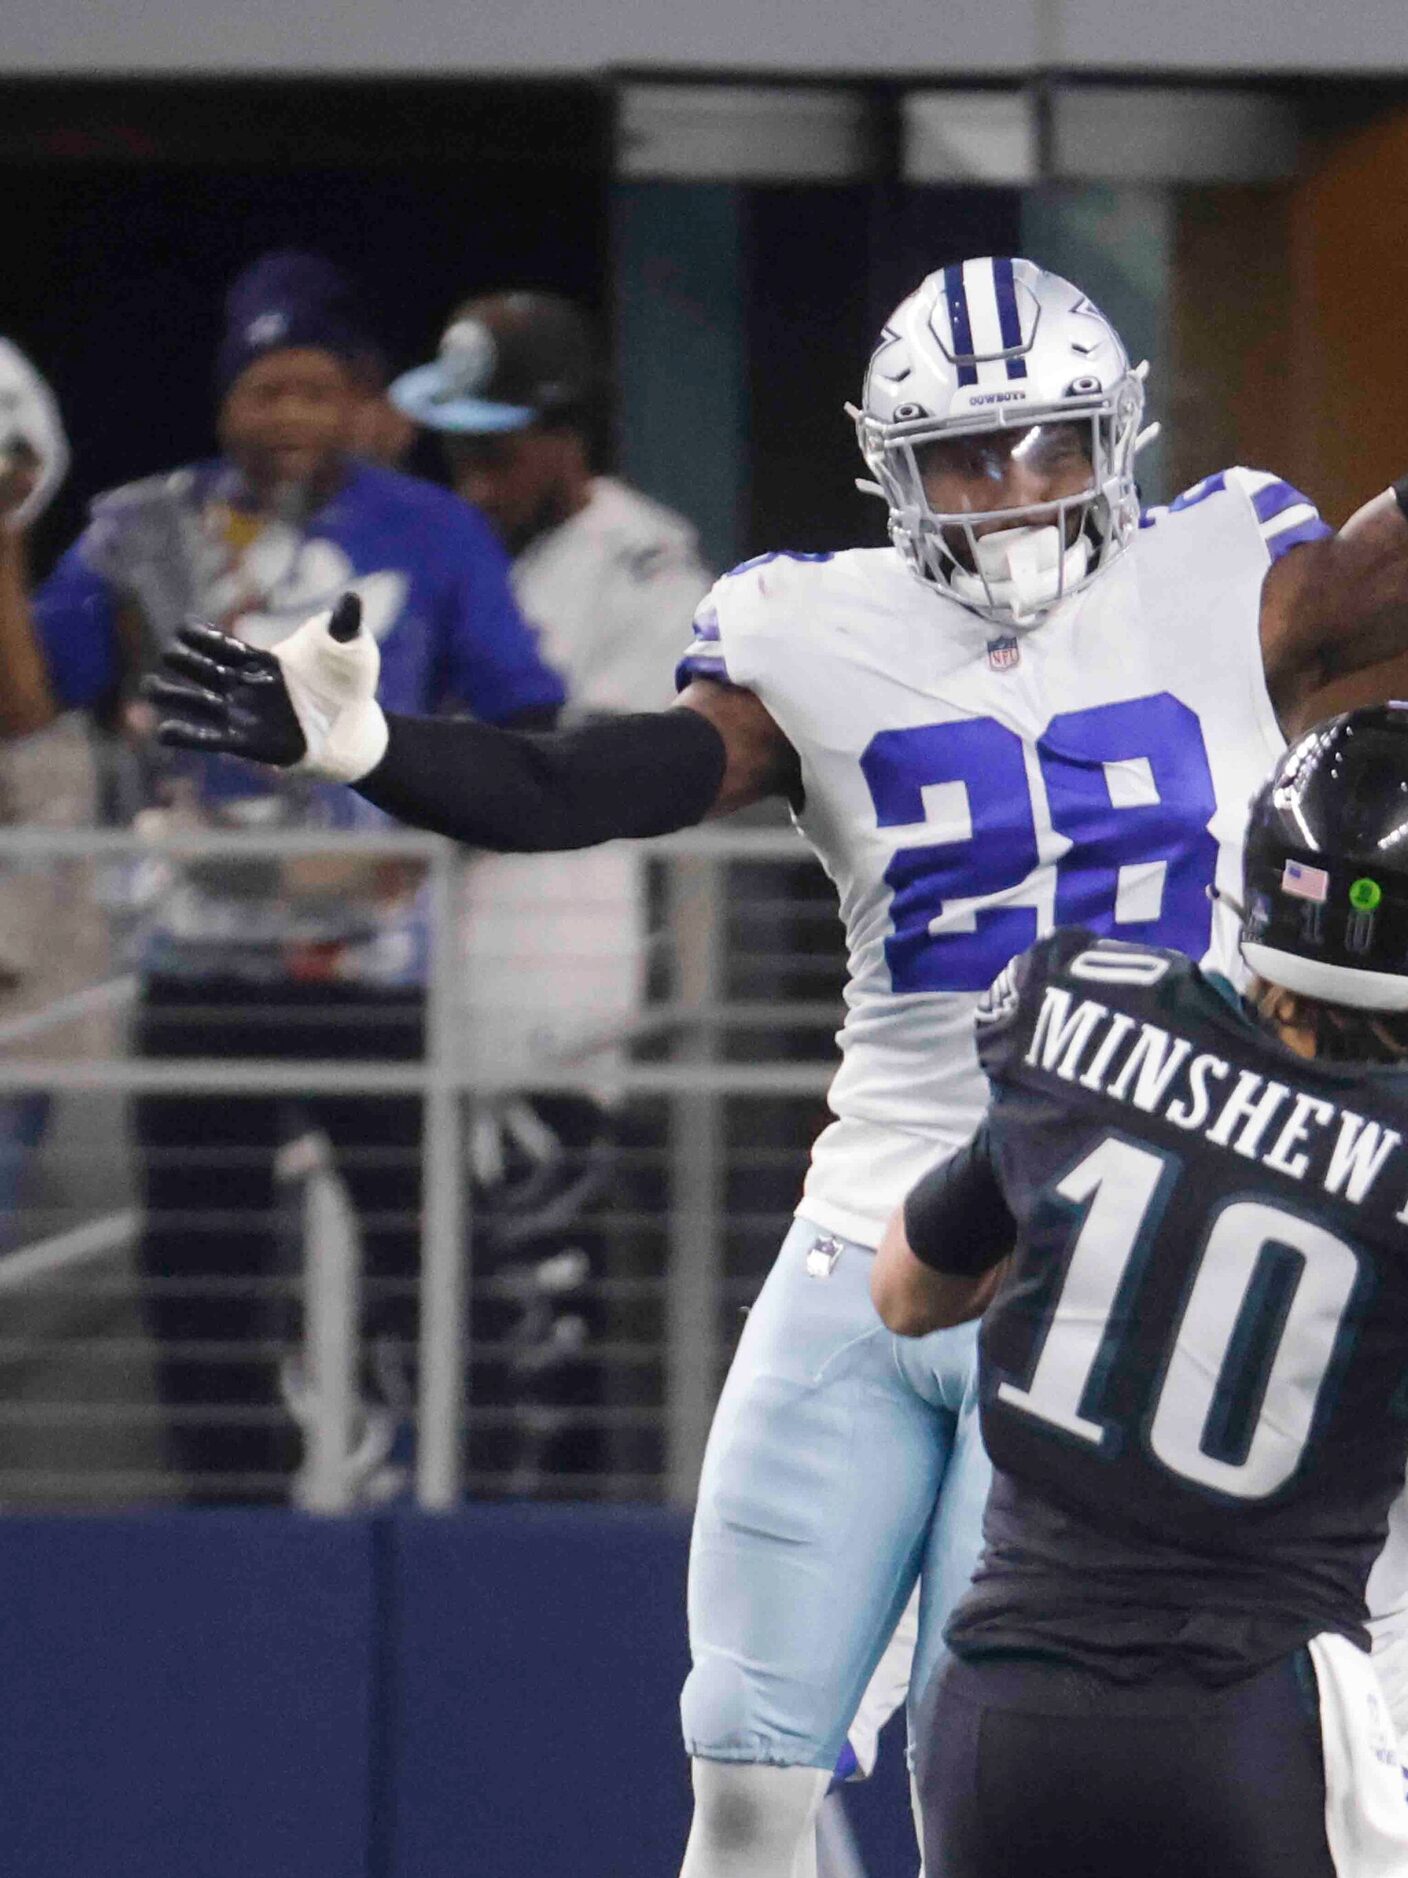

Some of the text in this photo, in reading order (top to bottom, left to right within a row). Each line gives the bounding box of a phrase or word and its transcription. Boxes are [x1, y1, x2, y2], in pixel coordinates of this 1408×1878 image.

[859, 690, 1221, 993] 28
[1025, 986, 1403, 1205] MINSHEW
[998, 1137, 1359, 1500] 10
